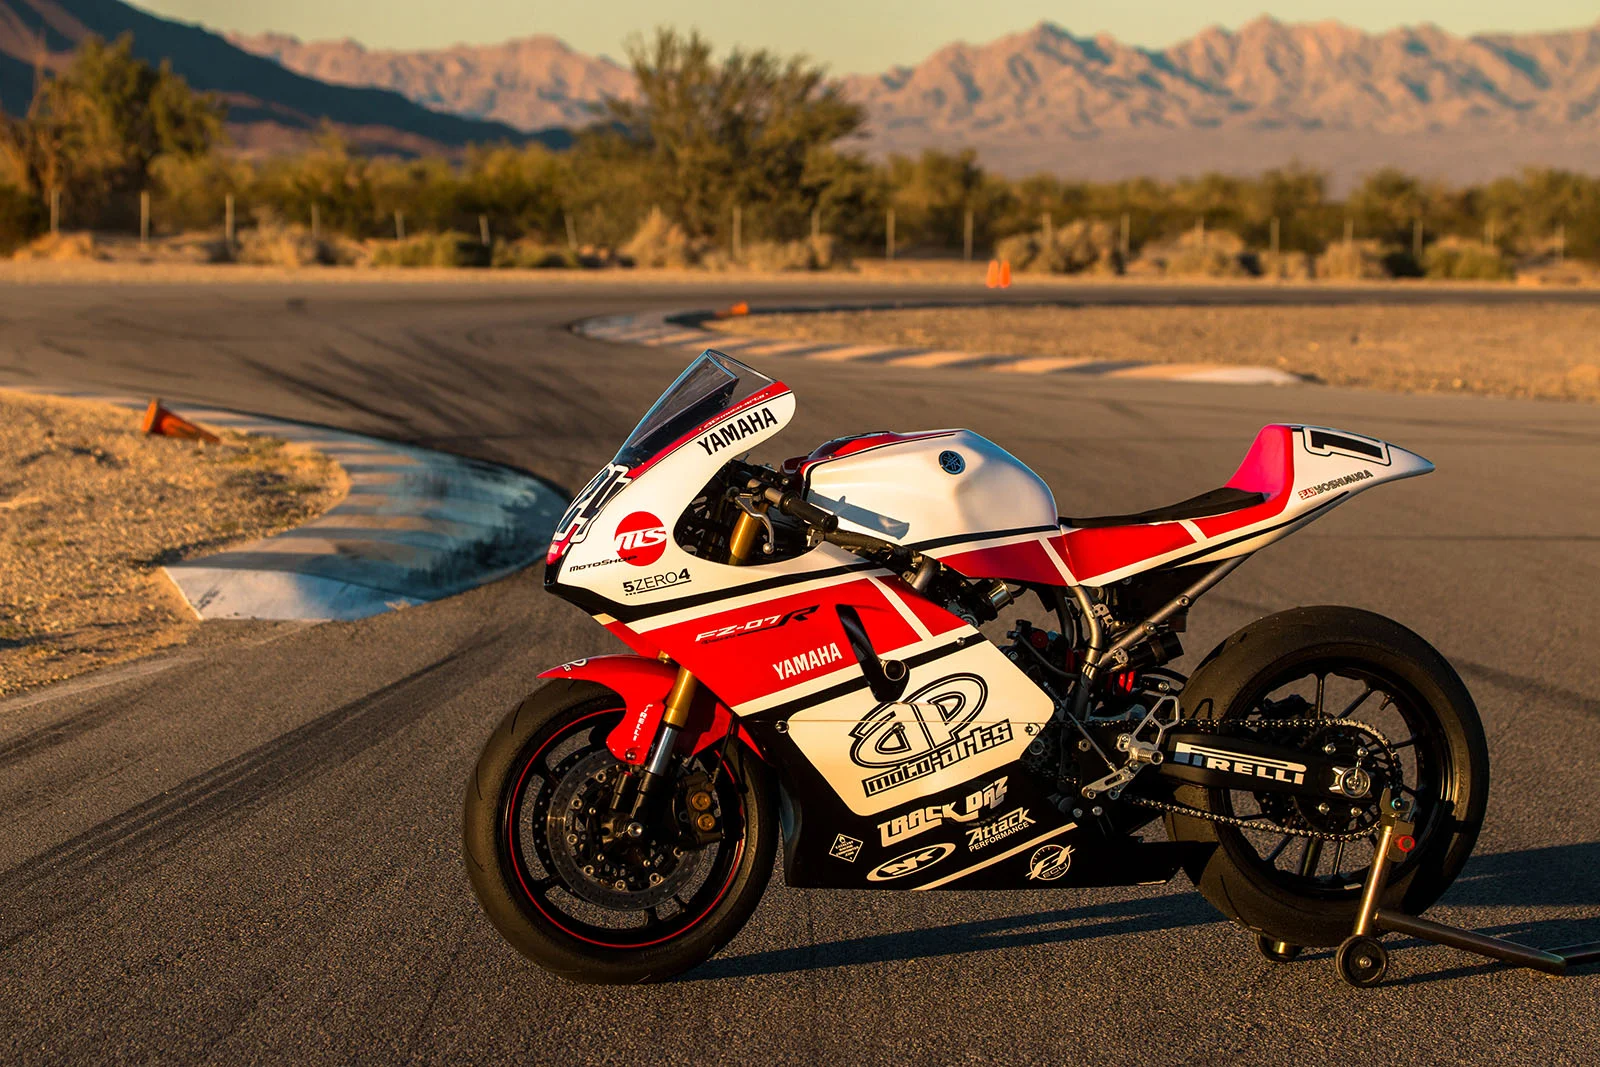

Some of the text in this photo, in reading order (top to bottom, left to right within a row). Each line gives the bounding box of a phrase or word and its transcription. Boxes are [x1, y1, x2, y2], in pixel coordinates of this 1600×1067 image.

[697, 407, 778, 456] YAMAHA
[1313, 470, 1374, 494] YOSHIMURA
[623, 568, 692, 596] 5ZERO4
[772, 642, 843, 681] YAMAHA
[1174, 742, 1307, 785] PIRELLI
[877, 801, 979, 847] TRACK
[965, 806, 1037, 848] Attack
[968, 821, 1030, 853] PERFORMANCE
